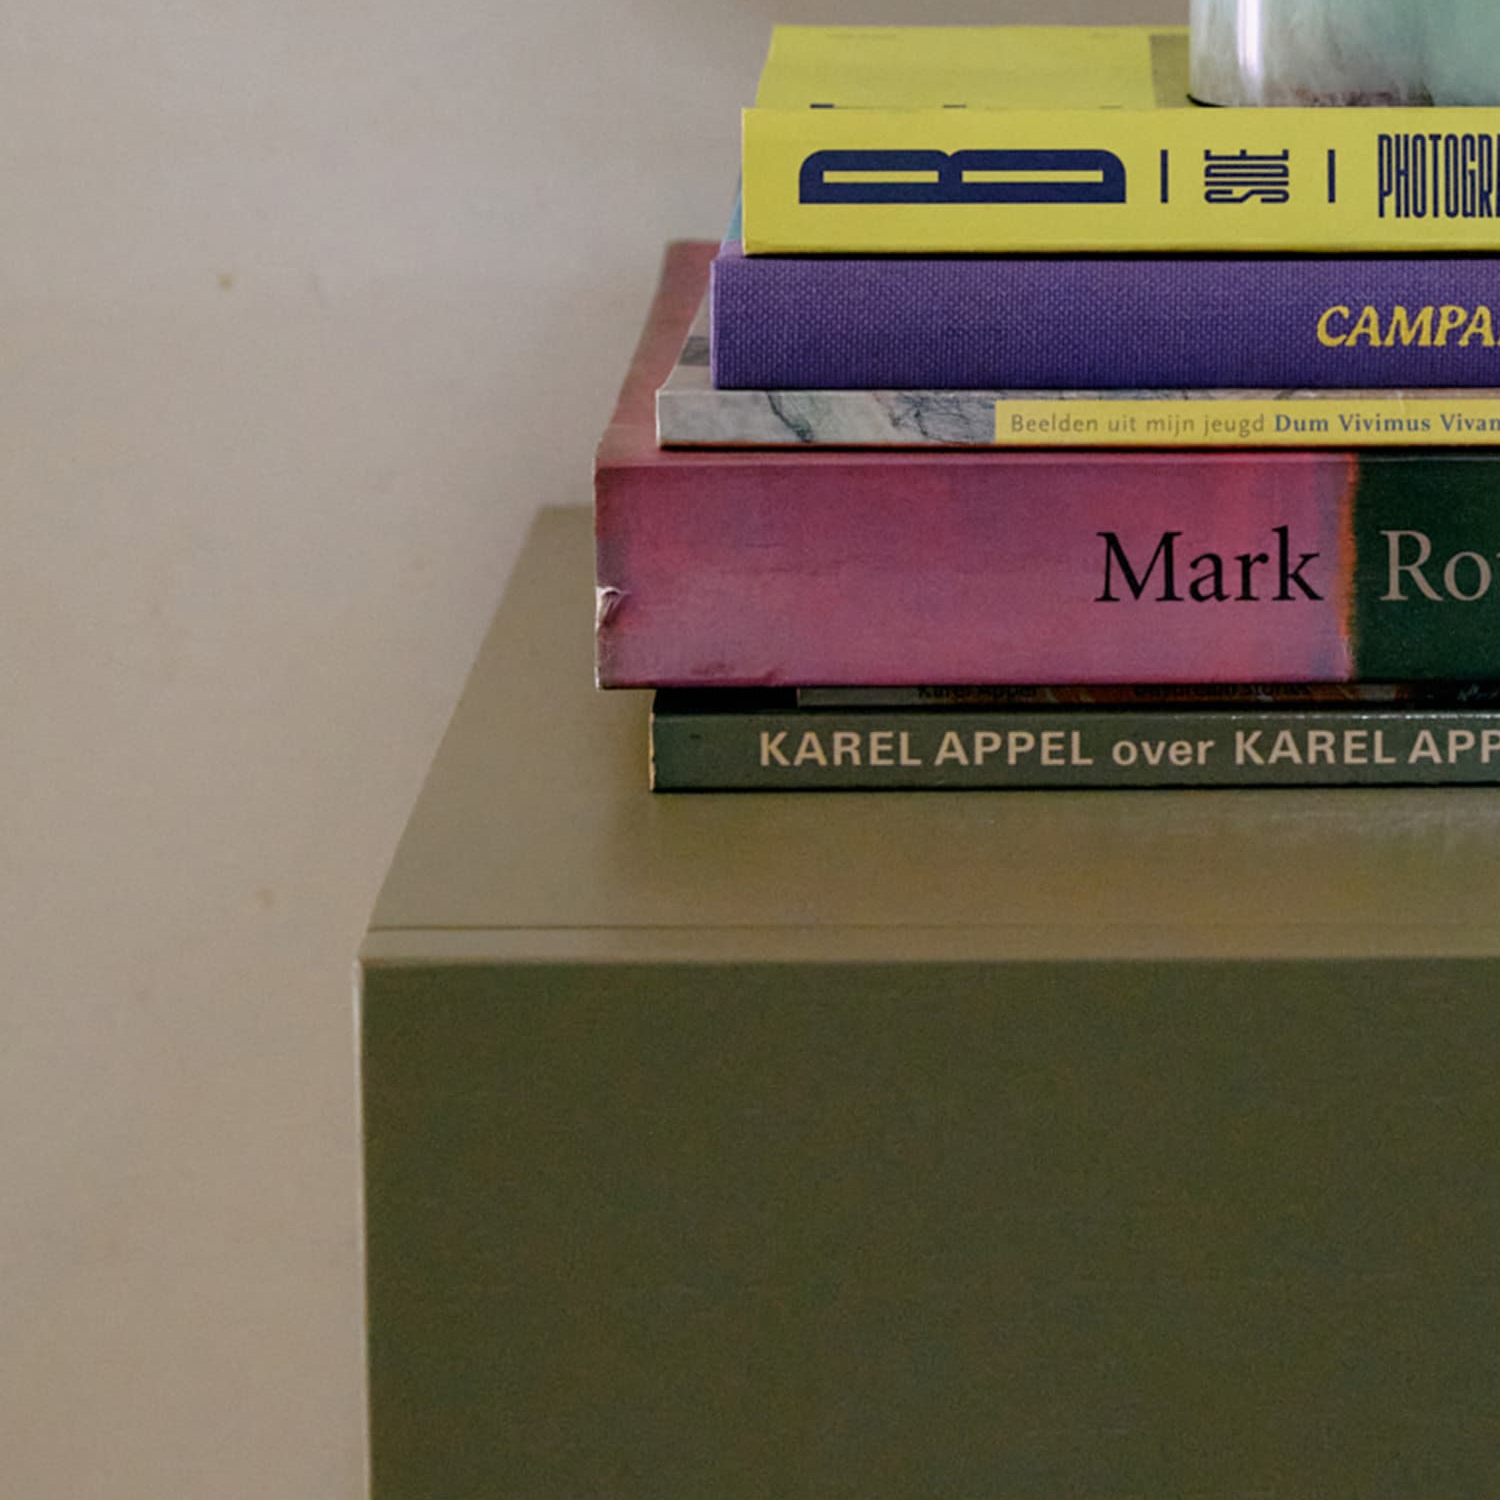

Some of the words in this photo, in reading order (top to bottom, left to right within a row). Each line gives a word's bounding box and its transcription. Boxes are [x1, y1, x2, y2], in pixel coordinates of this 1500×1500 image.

[798, 149, 1127, 204] B
[1203, 149, 1290, 204] SIDE
[1010, 413, 1099, 433] Beelden
[1107, 413, 1137, 433] uit
[1145, 414, 1195, 438] mijn
[1202, 413, 1265, 438] jeugd
[1274, 414, 1329, 433] Dum
[1338, 413, 1432, 433] Vivimus
[1094, 525, 1324, 602] Mark
[759, 731, 922, 766] KAREL
[934, 731, 1094, 766] APPEL
[1111, 738, 1215, 766] over
[1234, 730, 1396, 765] KAREL
